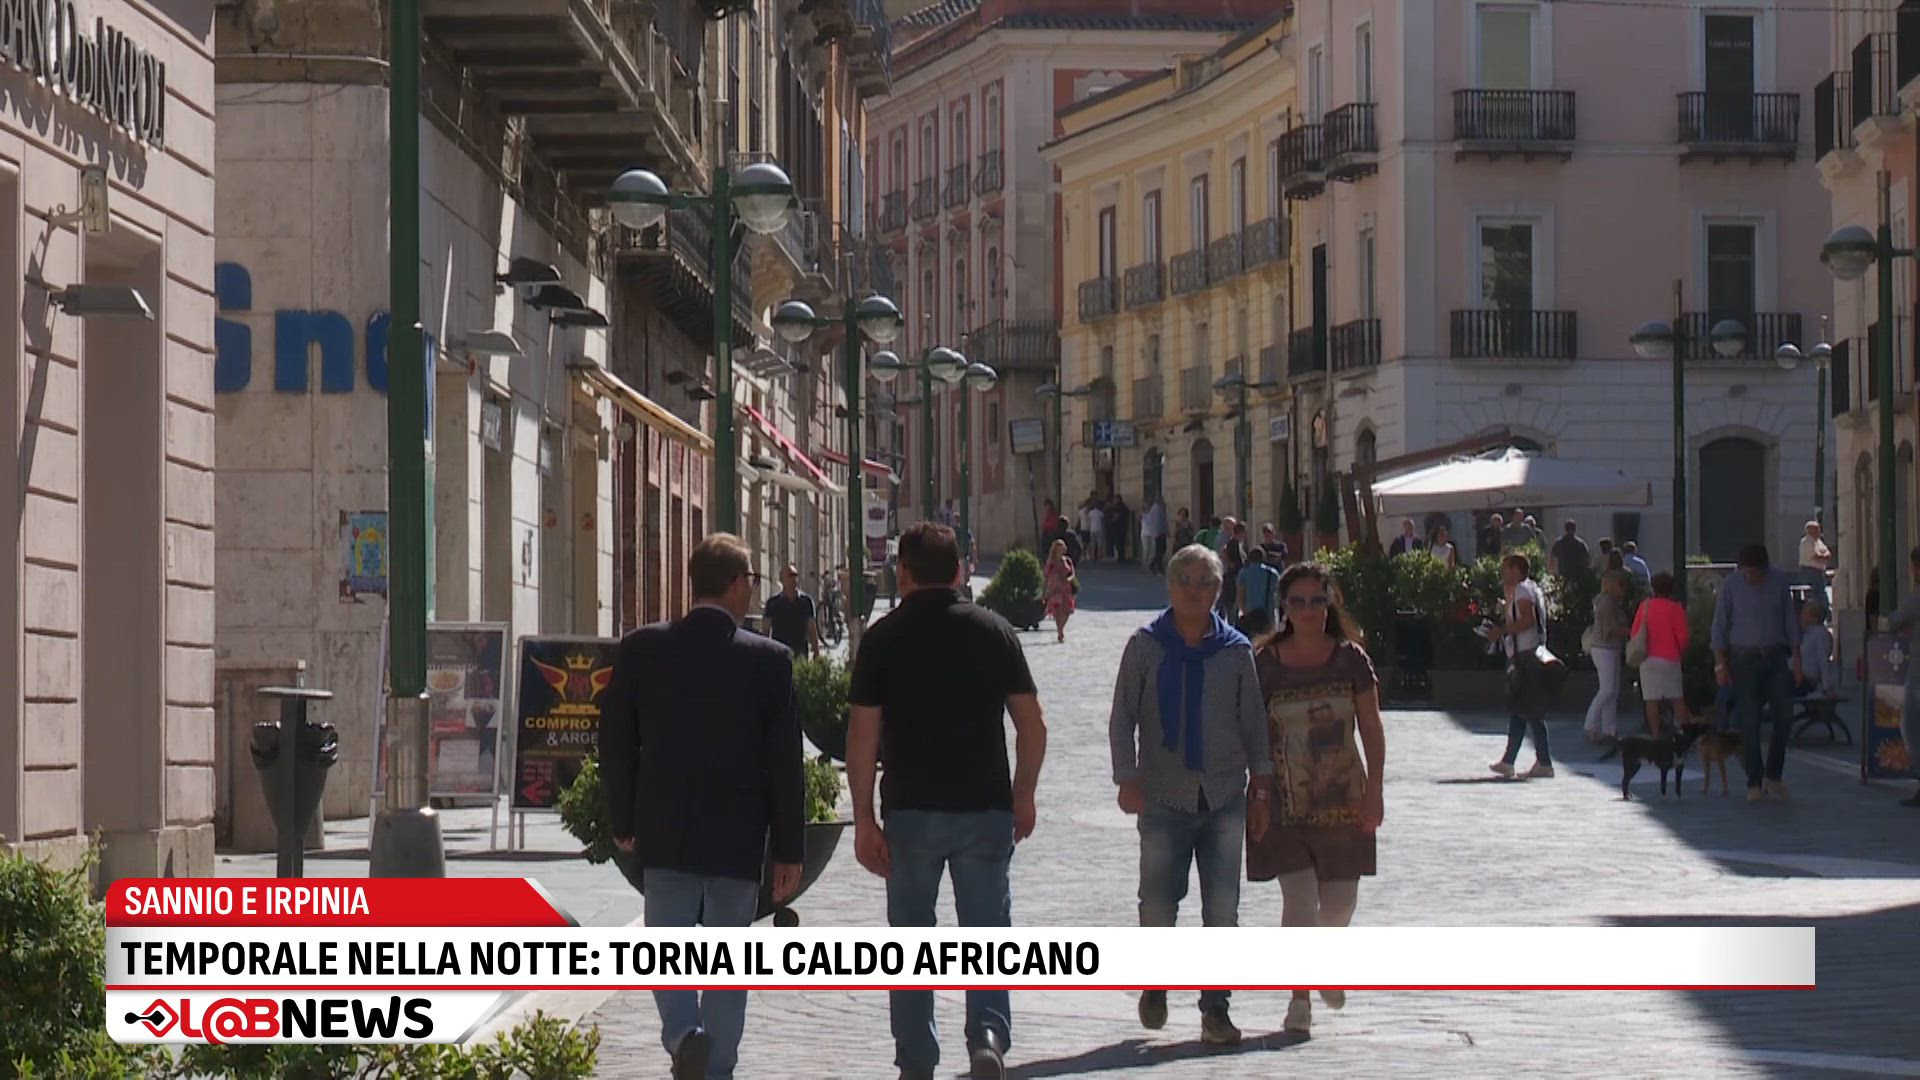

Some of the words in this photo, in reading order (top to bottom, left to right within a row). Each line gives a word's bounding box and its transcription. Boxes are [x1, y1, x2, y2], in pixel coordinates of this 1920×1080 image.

[96, 17, 166, 152] NAPOLI
[524, 716, 592, 730] COMPRO
[547, 731, 559, 746] &
